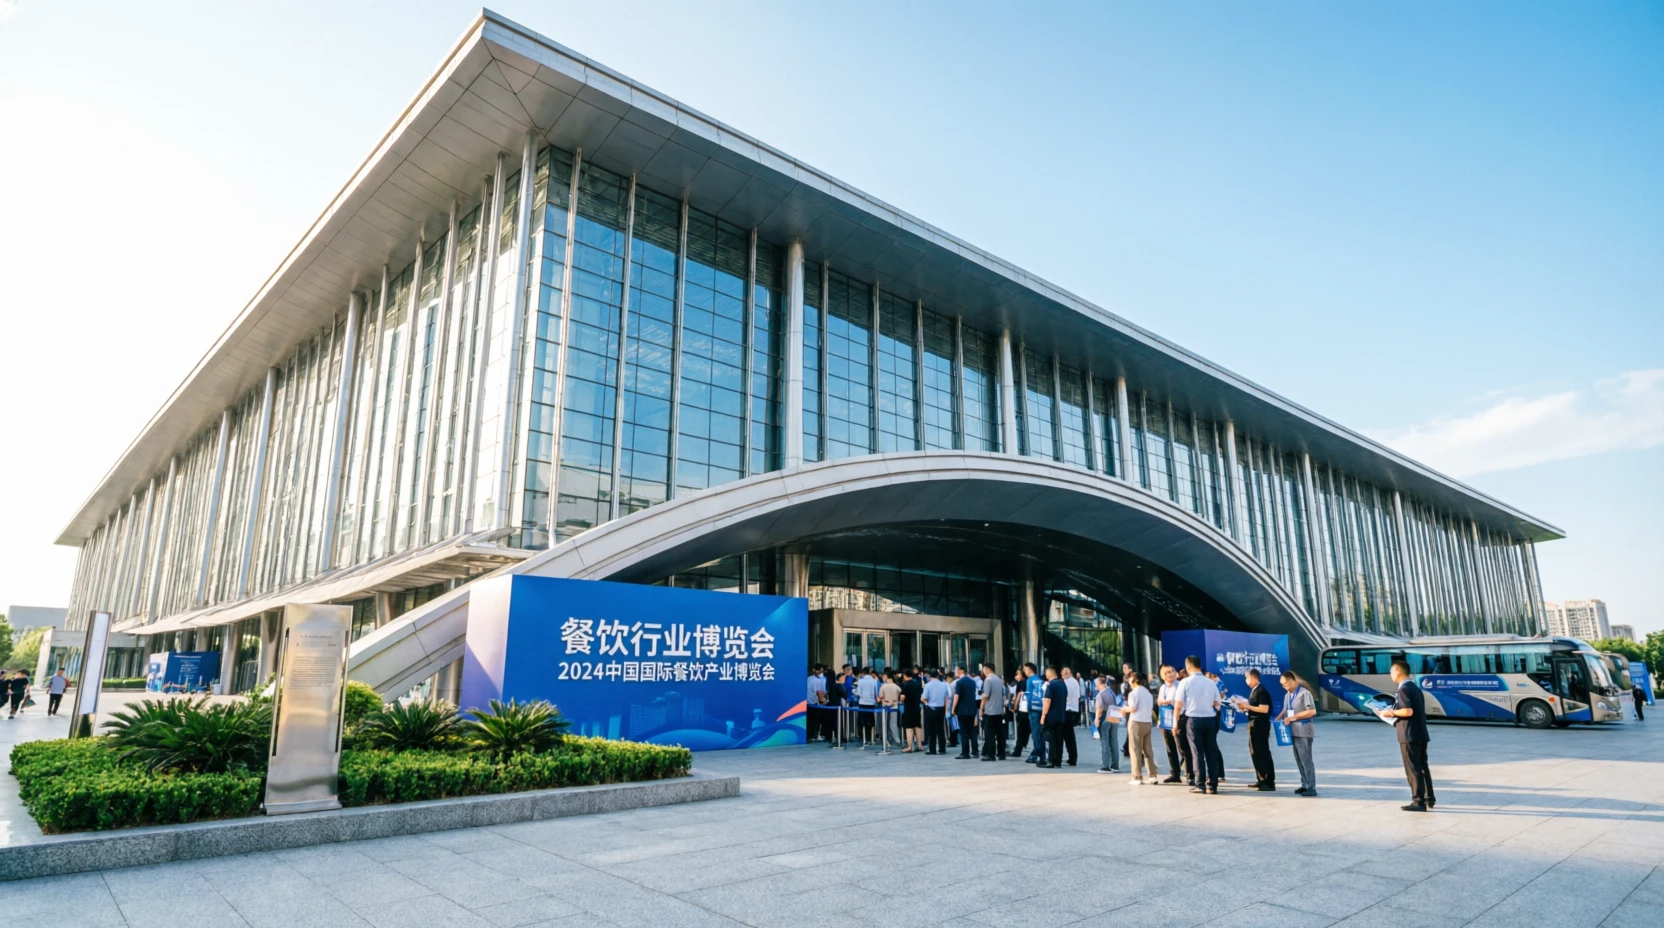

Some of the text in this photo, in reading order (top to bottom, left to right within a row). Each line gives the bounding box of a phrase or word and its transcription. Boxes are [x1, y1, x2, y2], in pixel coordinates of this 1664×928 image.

[560, 617, 775, 659] 餐饮行业博览会
[558, 660, 775, 682] 2024中国国际餐饮产业博览会
